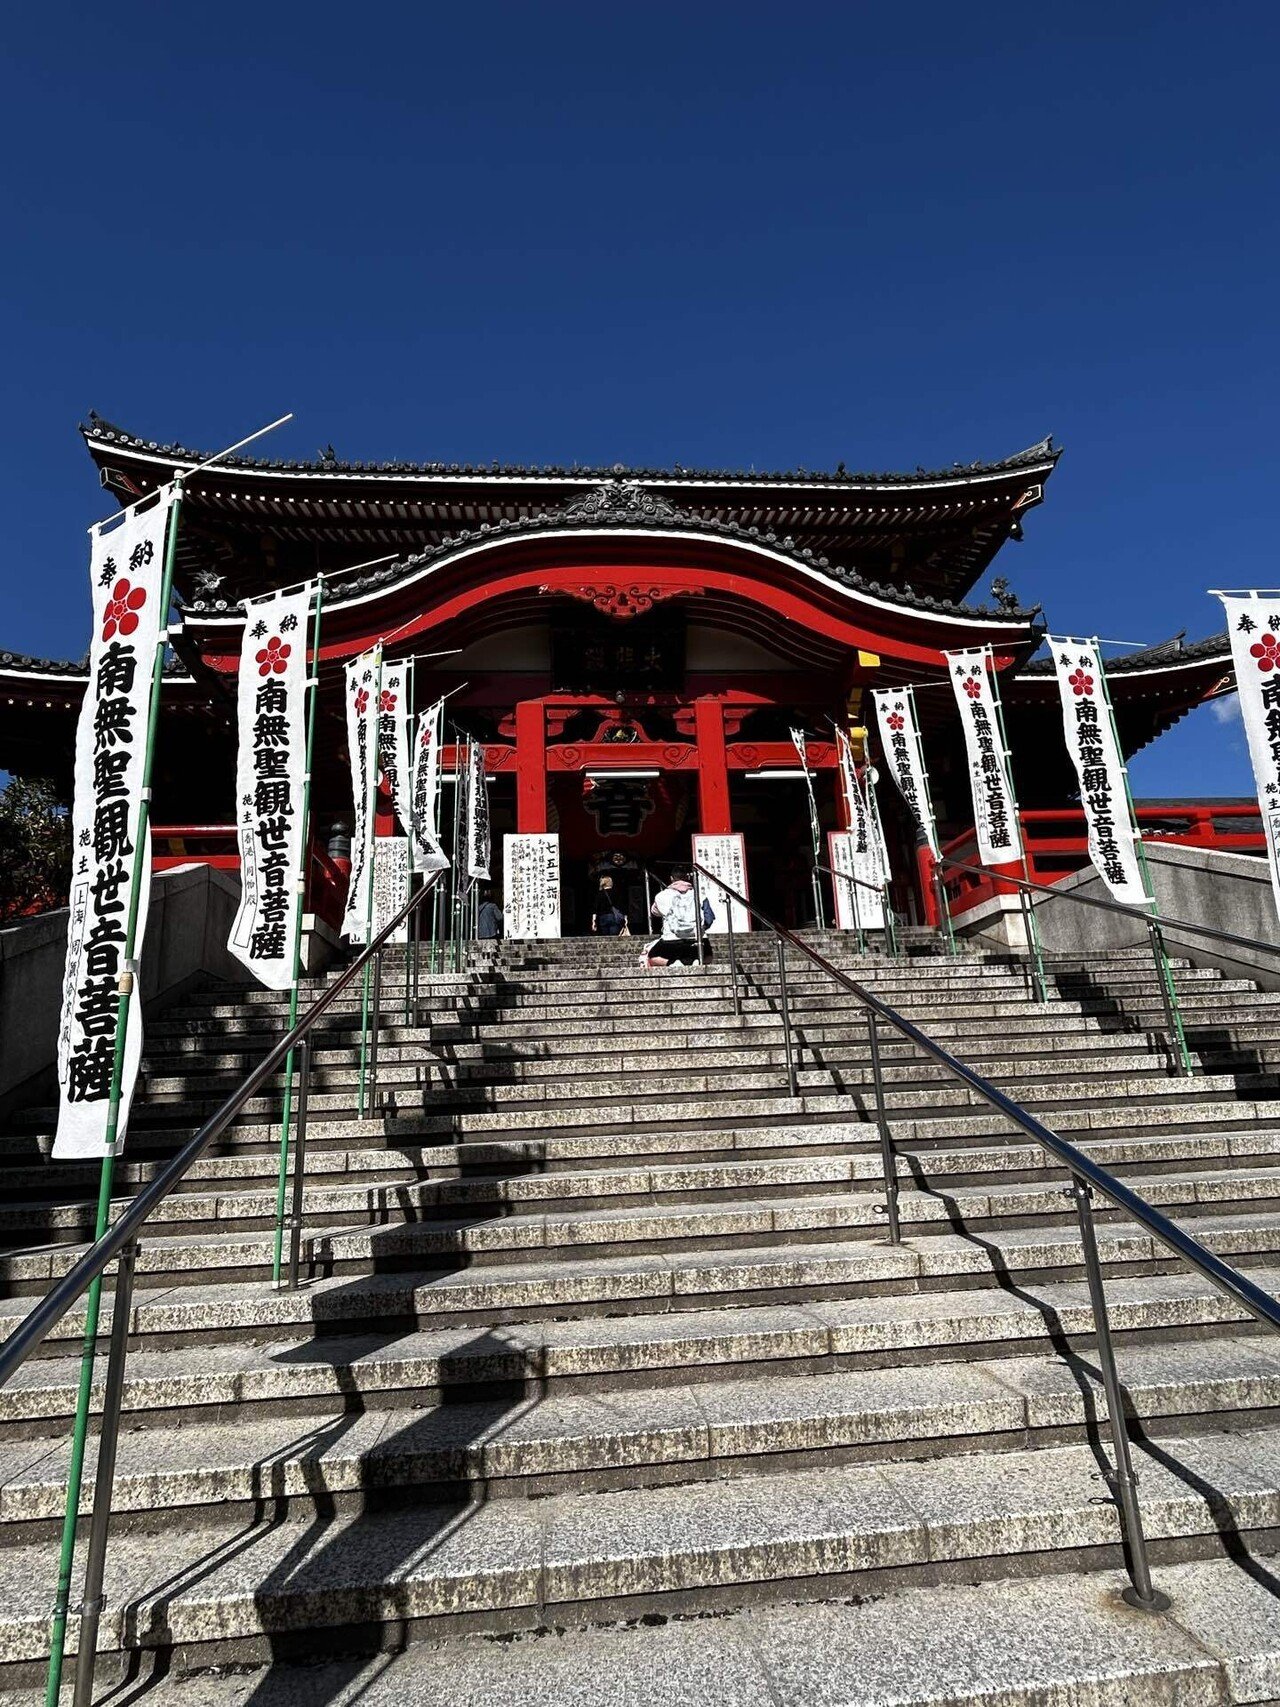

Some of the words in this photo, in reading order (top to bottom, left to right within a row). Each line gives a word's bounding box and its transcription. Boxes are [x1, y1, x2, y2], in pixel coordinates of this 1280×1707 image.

[97, 539, 154, 588] 奉納
[249, 614, 298, 640] 奉納
[954, 664, 982, 677] 奉納
[1058, 653, 1093, 668] 奉納
[349, 669, 372, 692] 奉納
[879, 701, 904, 713] 奉納
[969, 700, 1012, 848] 南無聖観世音菩薩
[1074, 698, 1127, 885] 南無聖観世音菩薩
[242, 793, 253, 823] 施主
[1264, 782, 1280, 811] 施主
[250, 678, 295, 960] 南無聖観世音菩薩
[77, 827, 92, 875] 施主
[67, 641, 137, 1103] 南無聖観世音菩薩
[545, 841, 559, 916] 七五三詣り
